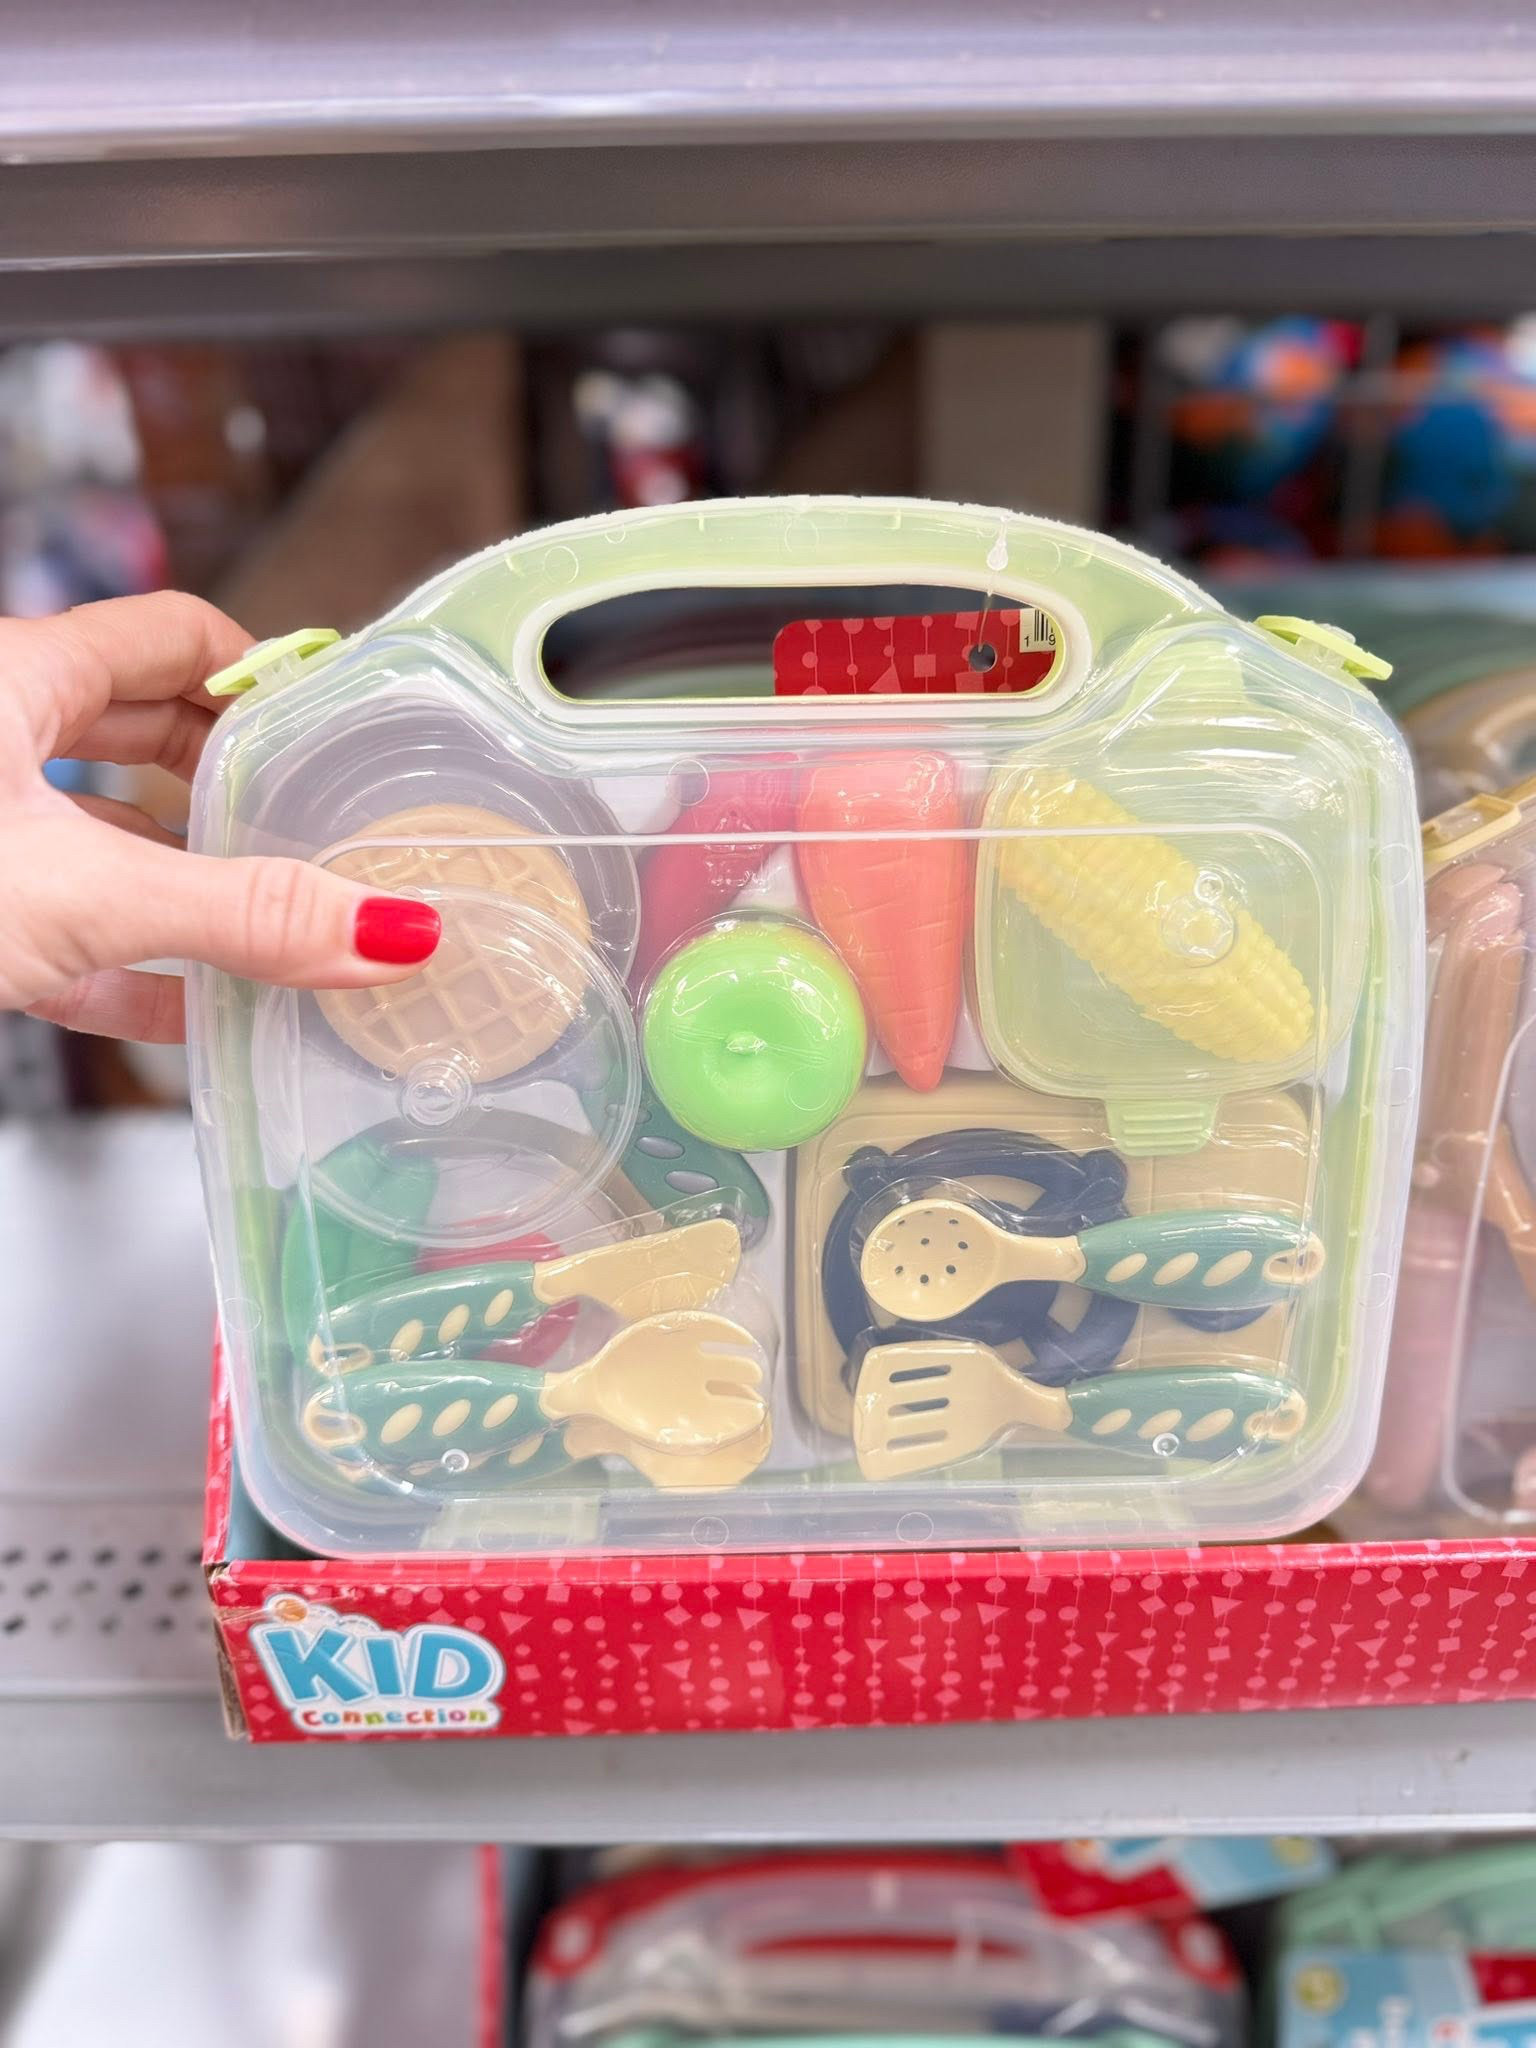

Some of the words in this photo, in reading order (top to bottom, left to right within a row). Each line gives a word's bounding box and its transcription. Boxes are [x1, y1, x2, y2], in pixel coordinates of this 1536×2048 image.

[1024, 635, 1030, 648] 1
[264, 1627, 494, 1704] KID
[302, 1708, 489, 1726] Connection
